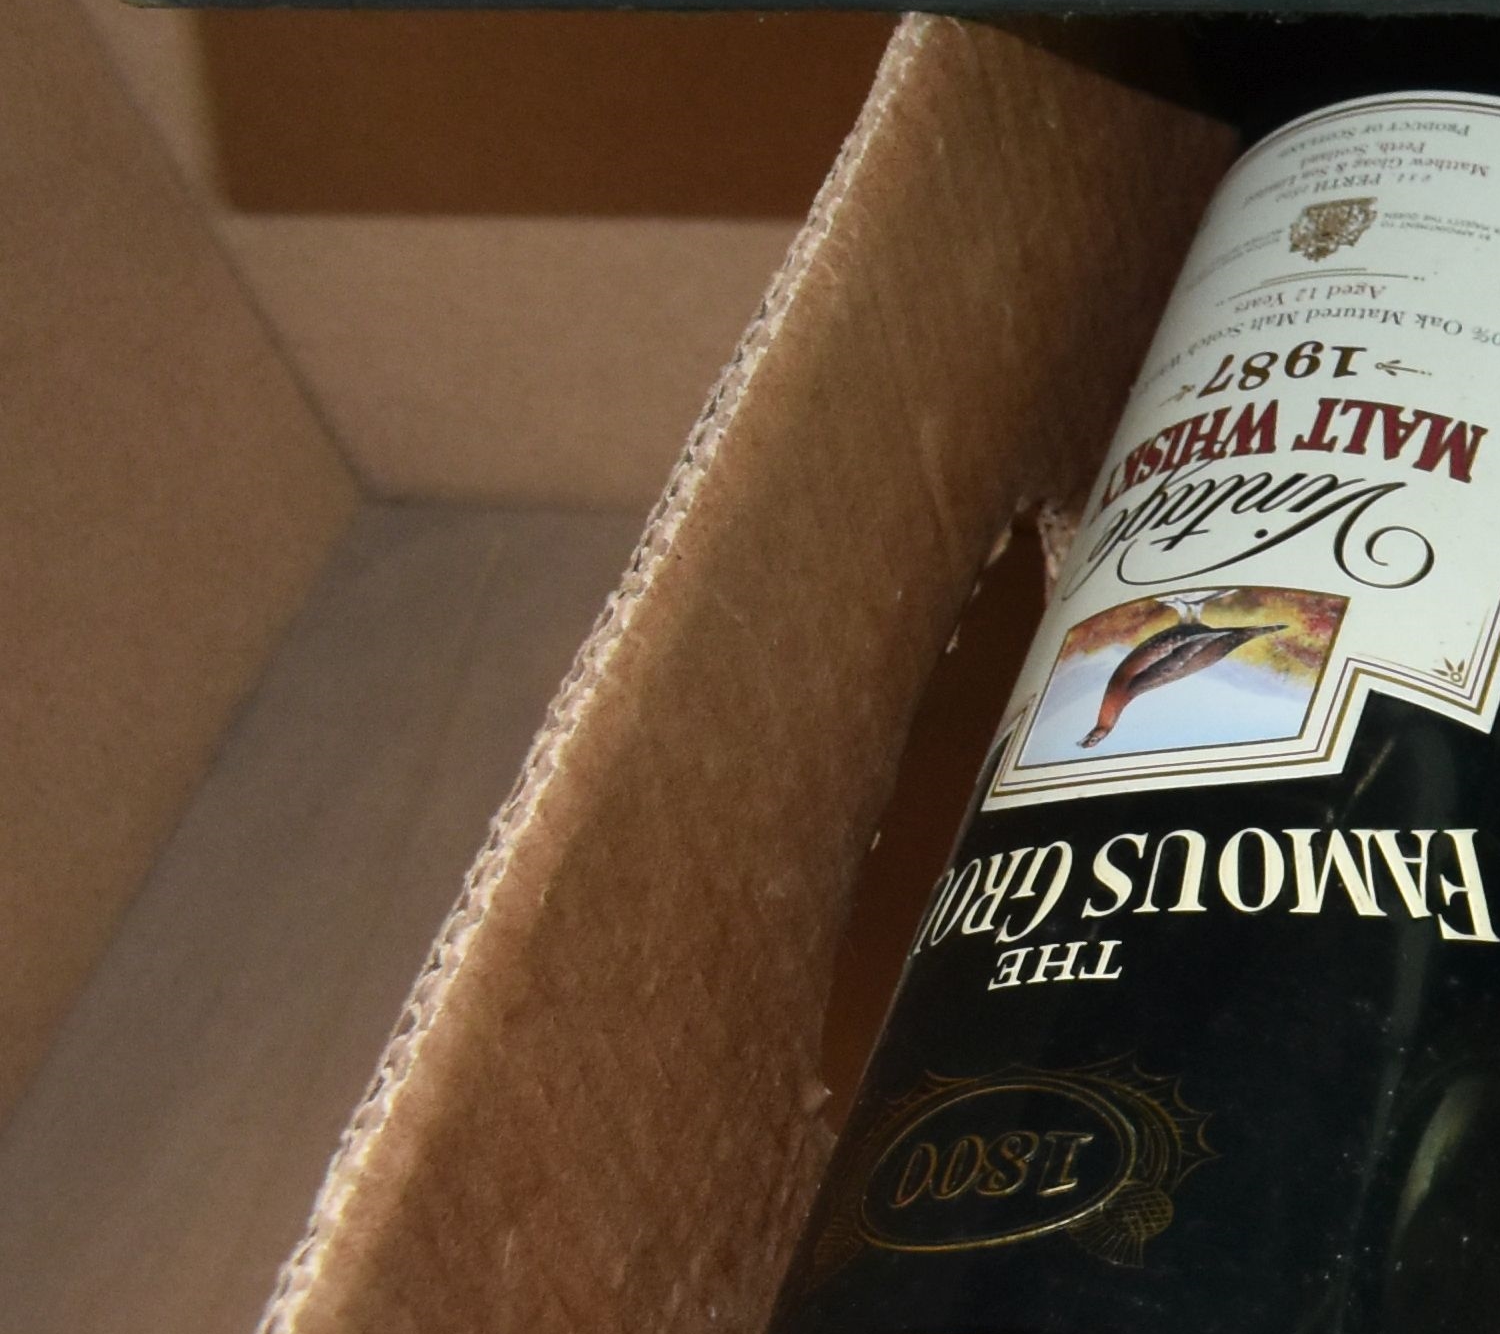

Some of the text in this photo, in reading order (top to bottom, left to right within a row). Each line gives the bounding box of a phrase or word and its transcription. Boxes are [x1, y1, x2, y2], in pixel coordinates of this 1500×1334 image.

[1304, 305, 1406, 328] Matured
[1326, 282, 1387, 302] Aged
[1249, 309, 1300, 334] Malt
[1414, 312, 1464, 336] Oak
[1196, 339, 1368, 399] 1987
[1100, 397, 1488, 506] MALT WHISKY
[1062, 454, 1435, 599] Vintage
[1082, 827, 1500, 943] FAMOUS
[988, 939, 1123, 991] THE
[887, 1129, 1095, 1209] 1800
